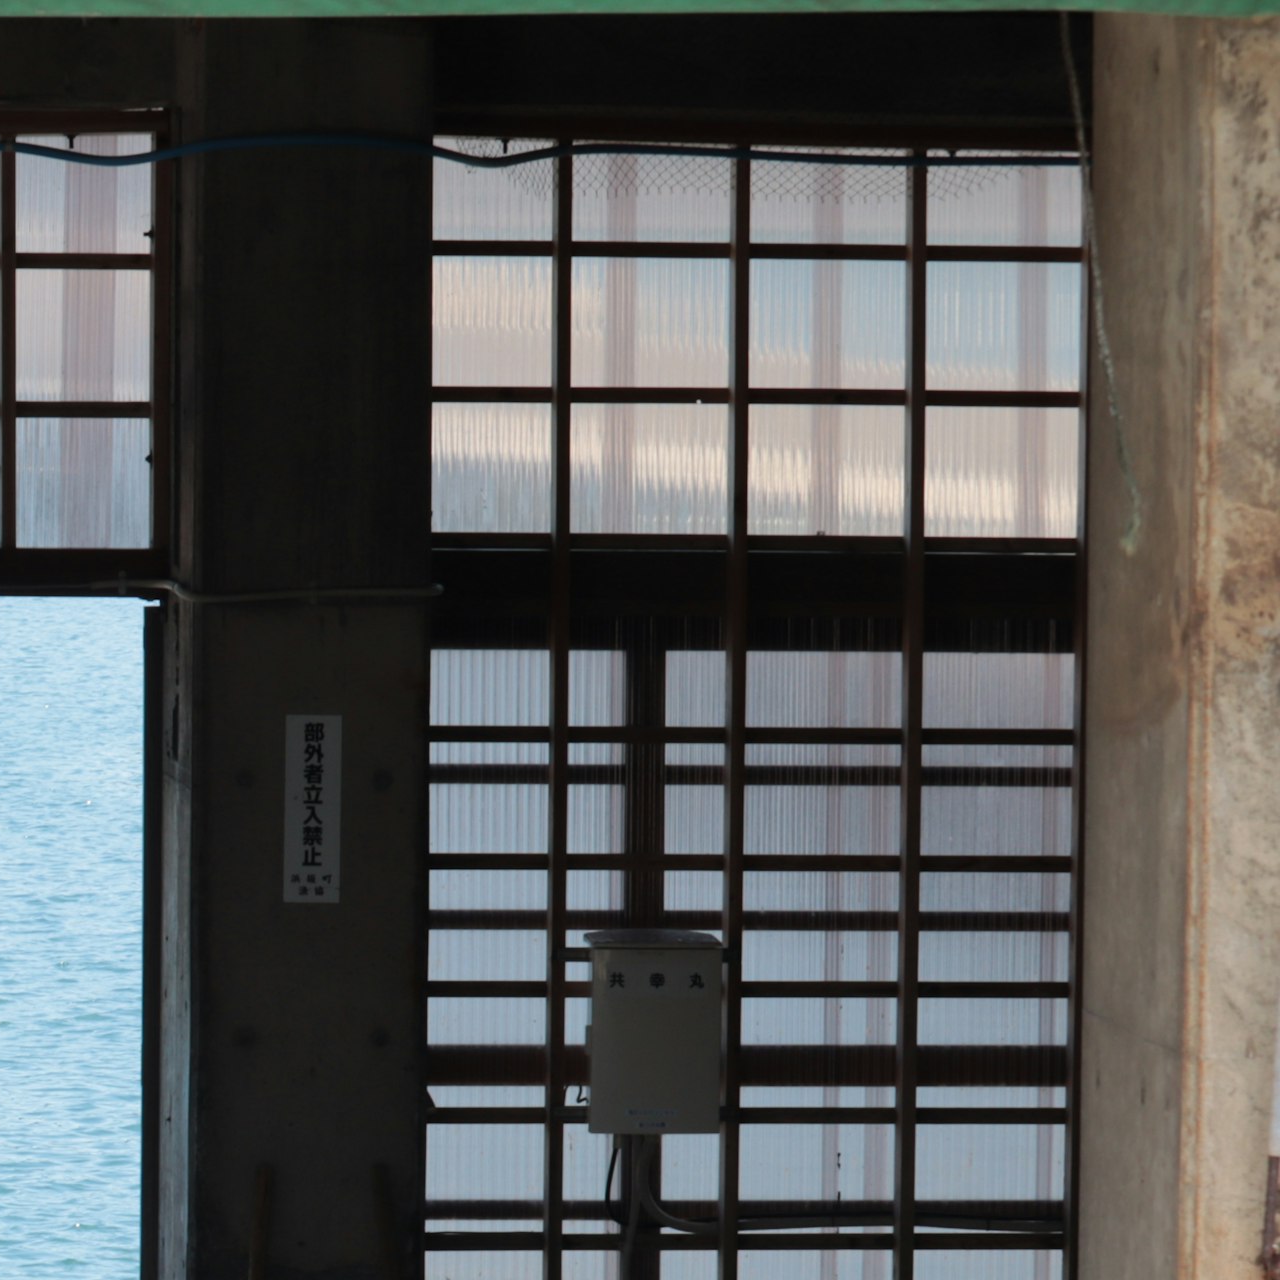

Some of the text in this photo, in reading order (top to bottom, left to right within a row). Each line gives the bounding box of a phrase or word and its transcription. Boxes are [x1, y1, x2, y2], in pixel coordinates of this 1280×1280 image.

[303, 723, 324, 866] 部外者立入禁止
